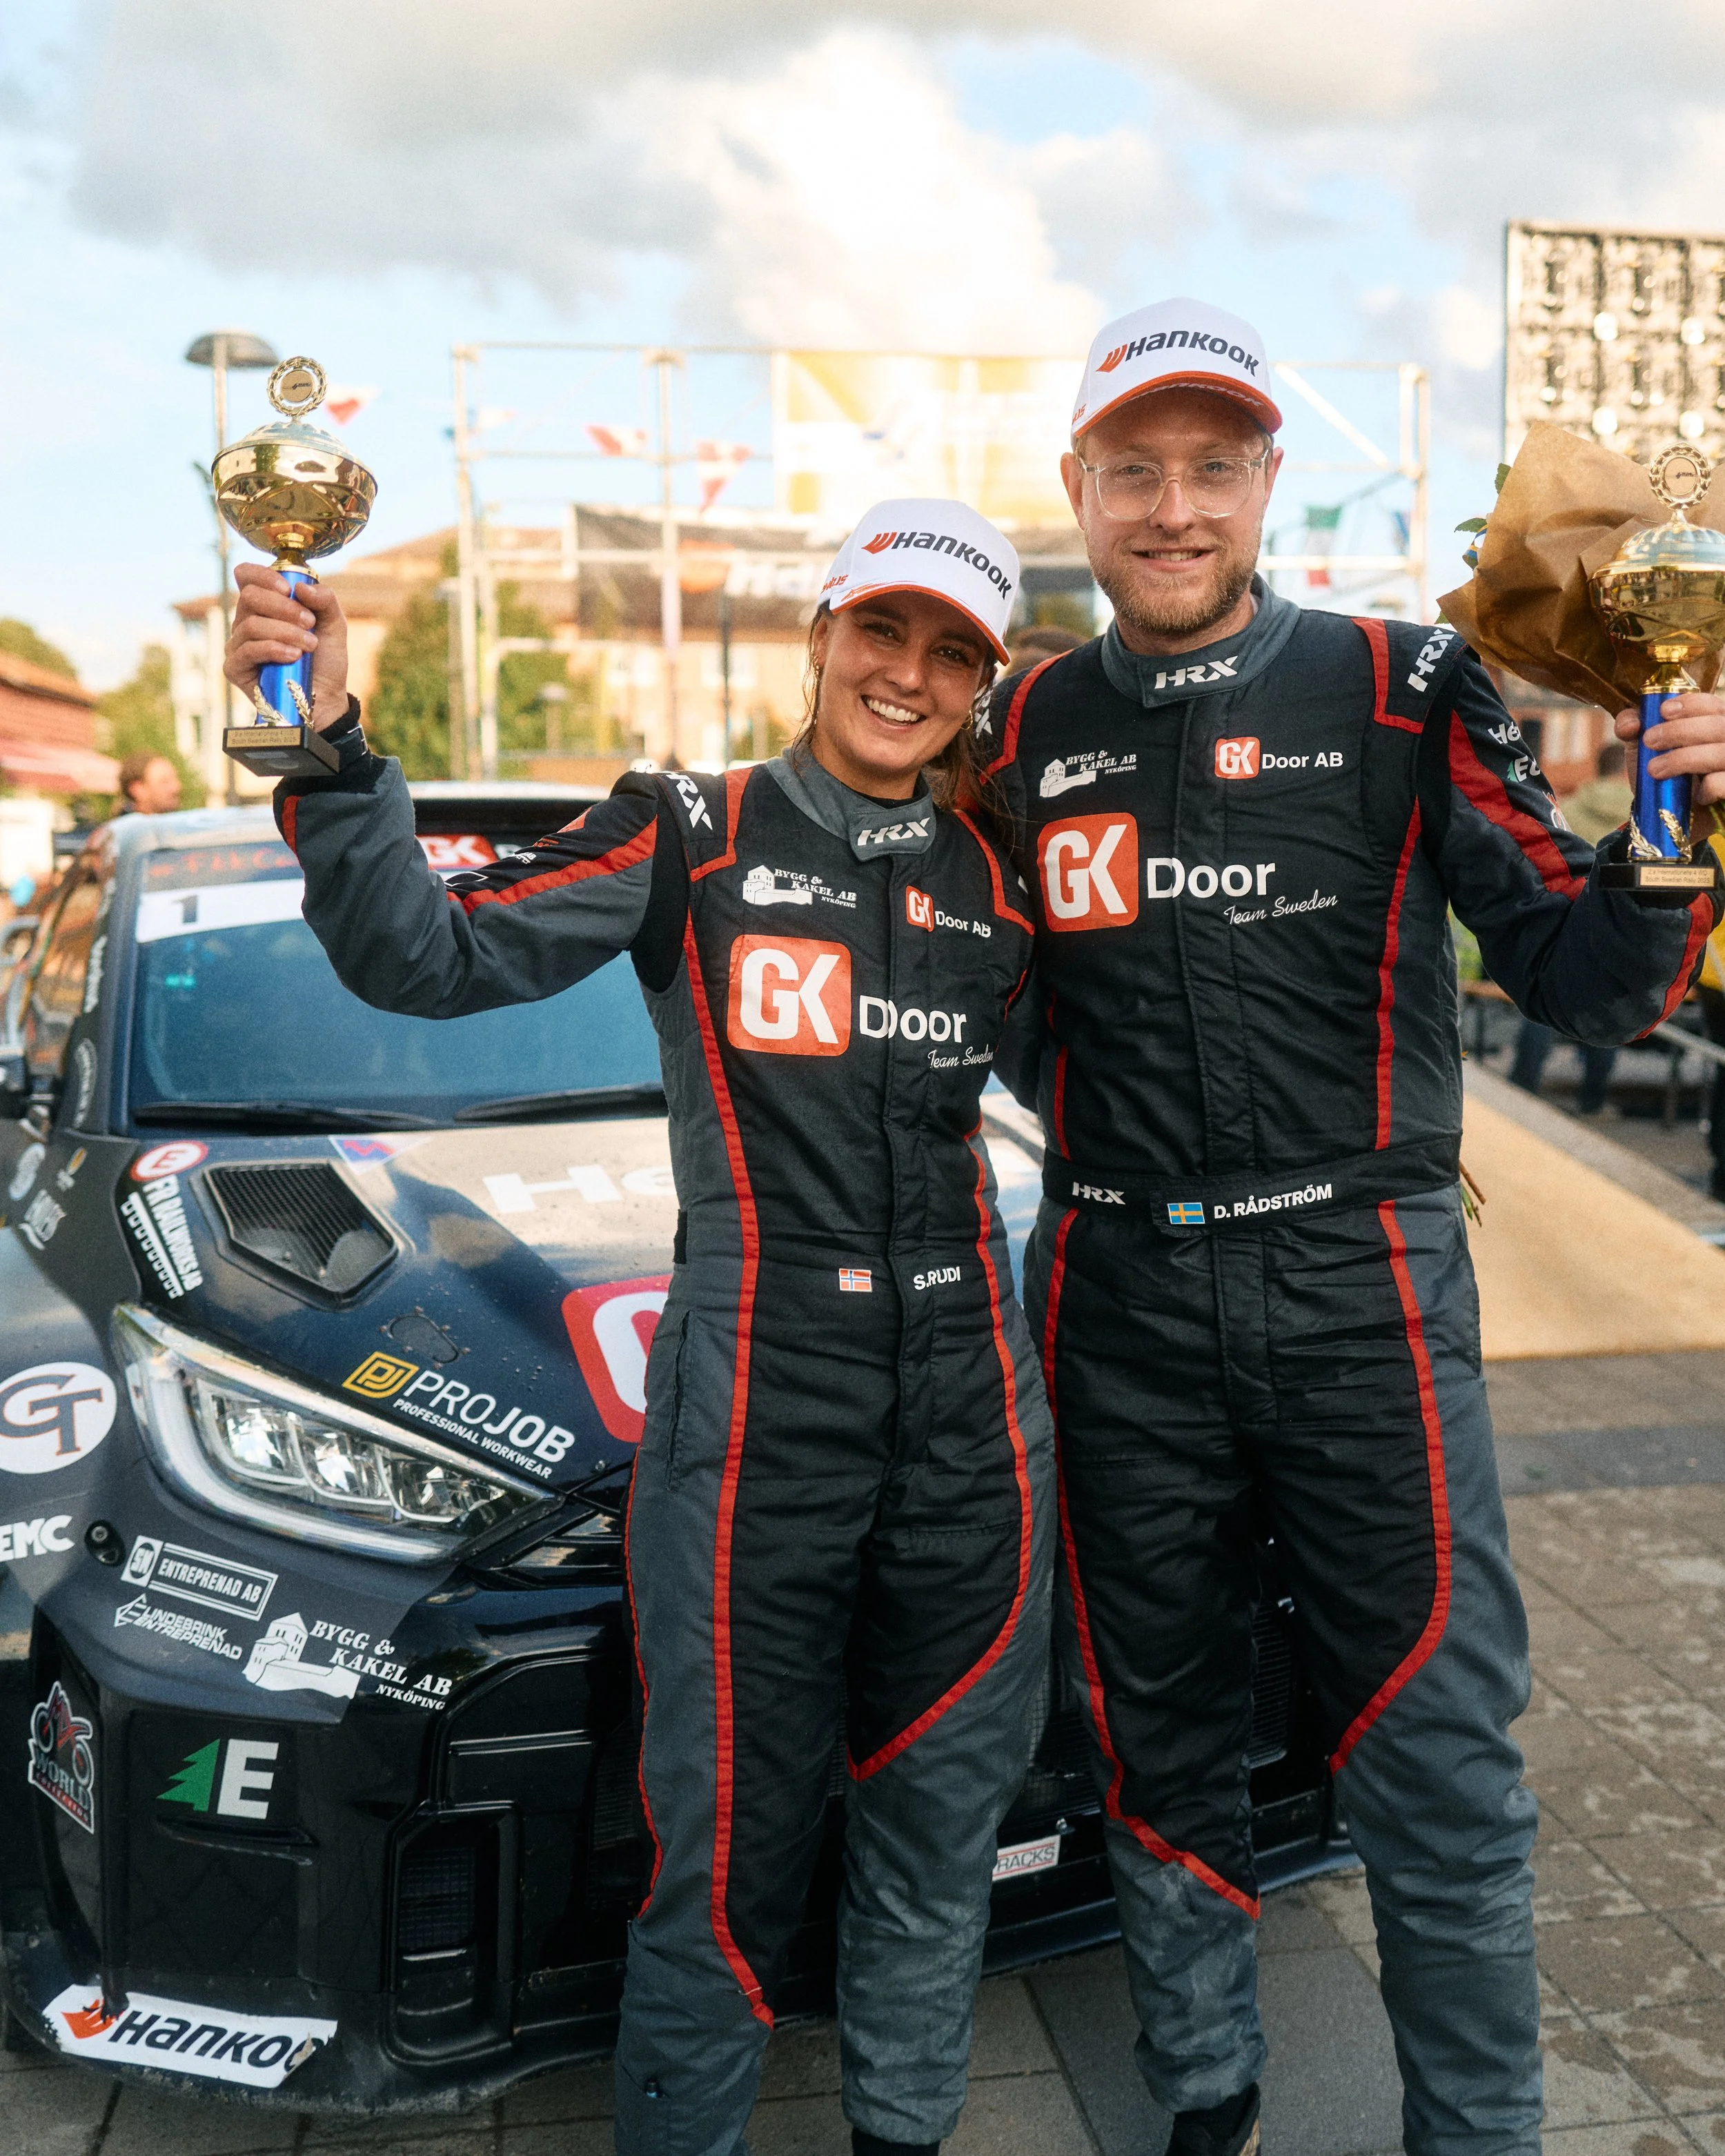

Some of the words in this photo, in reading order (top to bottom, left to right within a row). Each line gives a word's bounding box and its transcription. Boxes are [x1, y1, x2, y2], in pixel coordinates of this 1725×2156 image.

[1154, 655, 1238, 689] HRX
[1408, 629, 1455, 692] HRX
[1065, 752, 1096, 766] BYGG
[1098, 750, 1108, 759] &
[1078, 757, 1117, 772] KAKEL
[1121, 754, 1136, 765] AB
[1104, 764, 1136, 775] NYKÖPING
[1219, 741, 1256, 775] GK
[1262, 753, 1310, 769] Door
[1314, 751, 1344, 768] AB
[857, 817, 931, 847] HRX
[773, 868, 807, 883] BYGG
[810, 876, 823, 885] &
[1044, 824, 1128, 919] GK
[1147, 857, 1276, 899] Door
[791, 880, 834, 897] KAKEL
[837, 890, 857, 902] AB
[821, 896, 857, 909] NYKÖPING
[1223, 904, 1268, 925] Team
[1272, 889, 1339, 917] Sweden
[909, 891, 931, 928] GK
[934, 911, 969, 931] Door
[972, 920, 992, 938] AB
[740, 948, 840, 1044] GK
[859, 995, 967, 1043] Door
[927, 1049, 960, 1069] Team
[1072, 1182, 1126, 1205] HRX
[1214, 1205, 1231, 1219] D.
[1234, 1183, 1332, 1216] RÅDSTRÖM
[0, 1374, 103, 1456] GT
[403, 1370, 575, 1463] PROJOB
[393, 1398, 480, 1445] PROFESSIONAL
[480, 1436, 553, 1480] WORKWEAR
[158, 1558, 243, 1597] ENTREPRENAD
[240, 1583, 263, 1603] AB
[132, 1616, 243, 1660] ENTREPRENAD
[141, 1605, 228, 1641] LINDEBRINK
[309, 1620, 371, 1650] BYGG
[374, 1639, 395, 1656] &
[328, 1647, 408, 1685] KAKEL
[413, 1674, 453, 1696] AB
[375, 1683, 446, 1710] NYKÖPING
[217, 1738, 279, 1819] E
